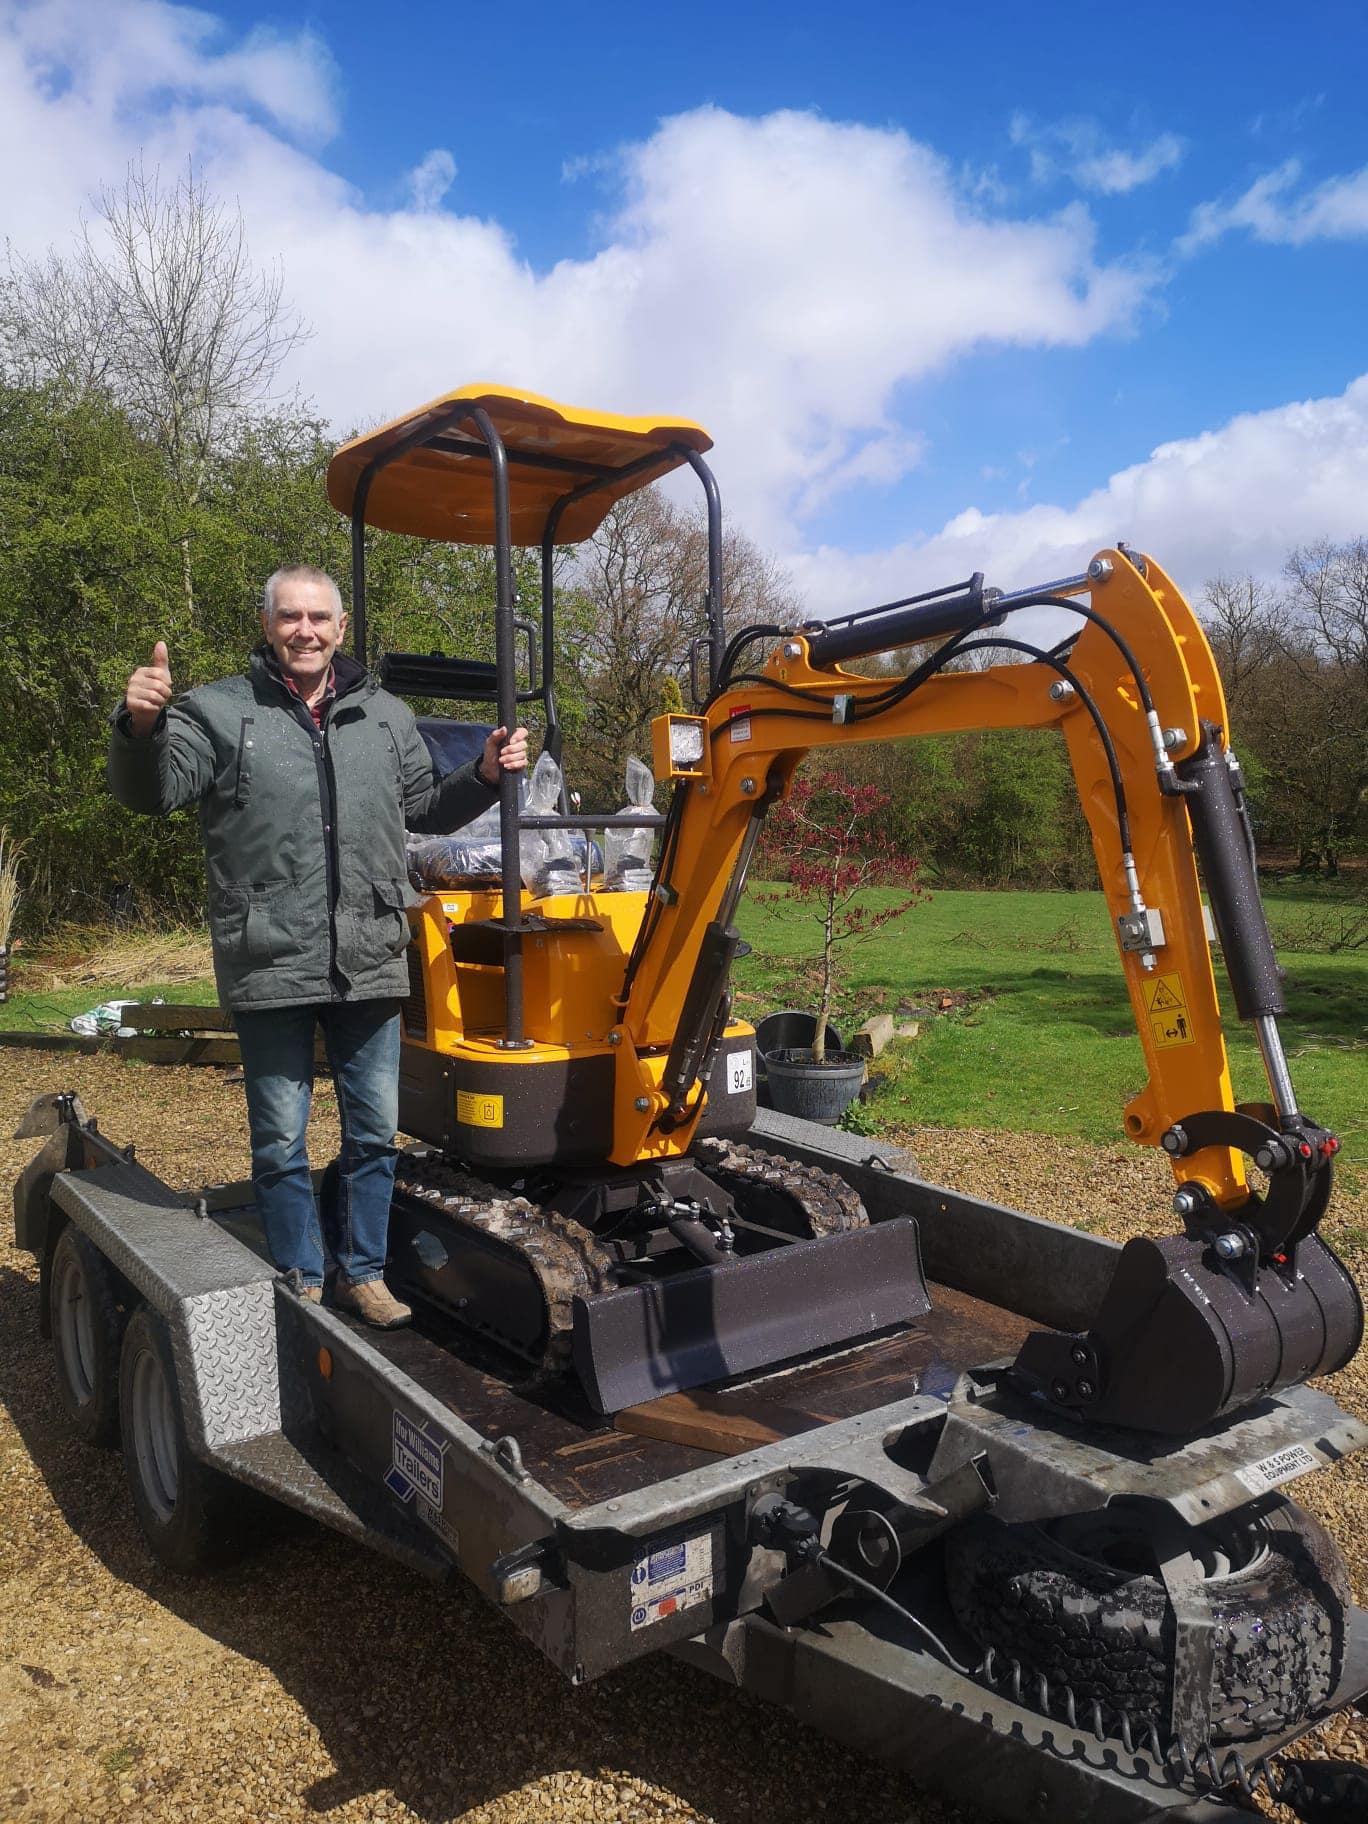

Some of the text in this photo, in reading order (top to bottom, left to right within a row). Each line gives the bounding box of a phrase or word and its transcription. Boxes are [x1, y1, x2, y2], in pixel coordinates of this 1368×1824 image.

[734, 1070, 744, 1089] 92
[396, 1417, 440, 1472] Ifor Williams
[396, 1445, 439, 1499] Trailers
[1256, 1447, 1306, 1472] W & S POWER
[1264, 1455, 1313, 1480] EQUIPMENT LTD
[690, 1582, 704, 1593] PDI
